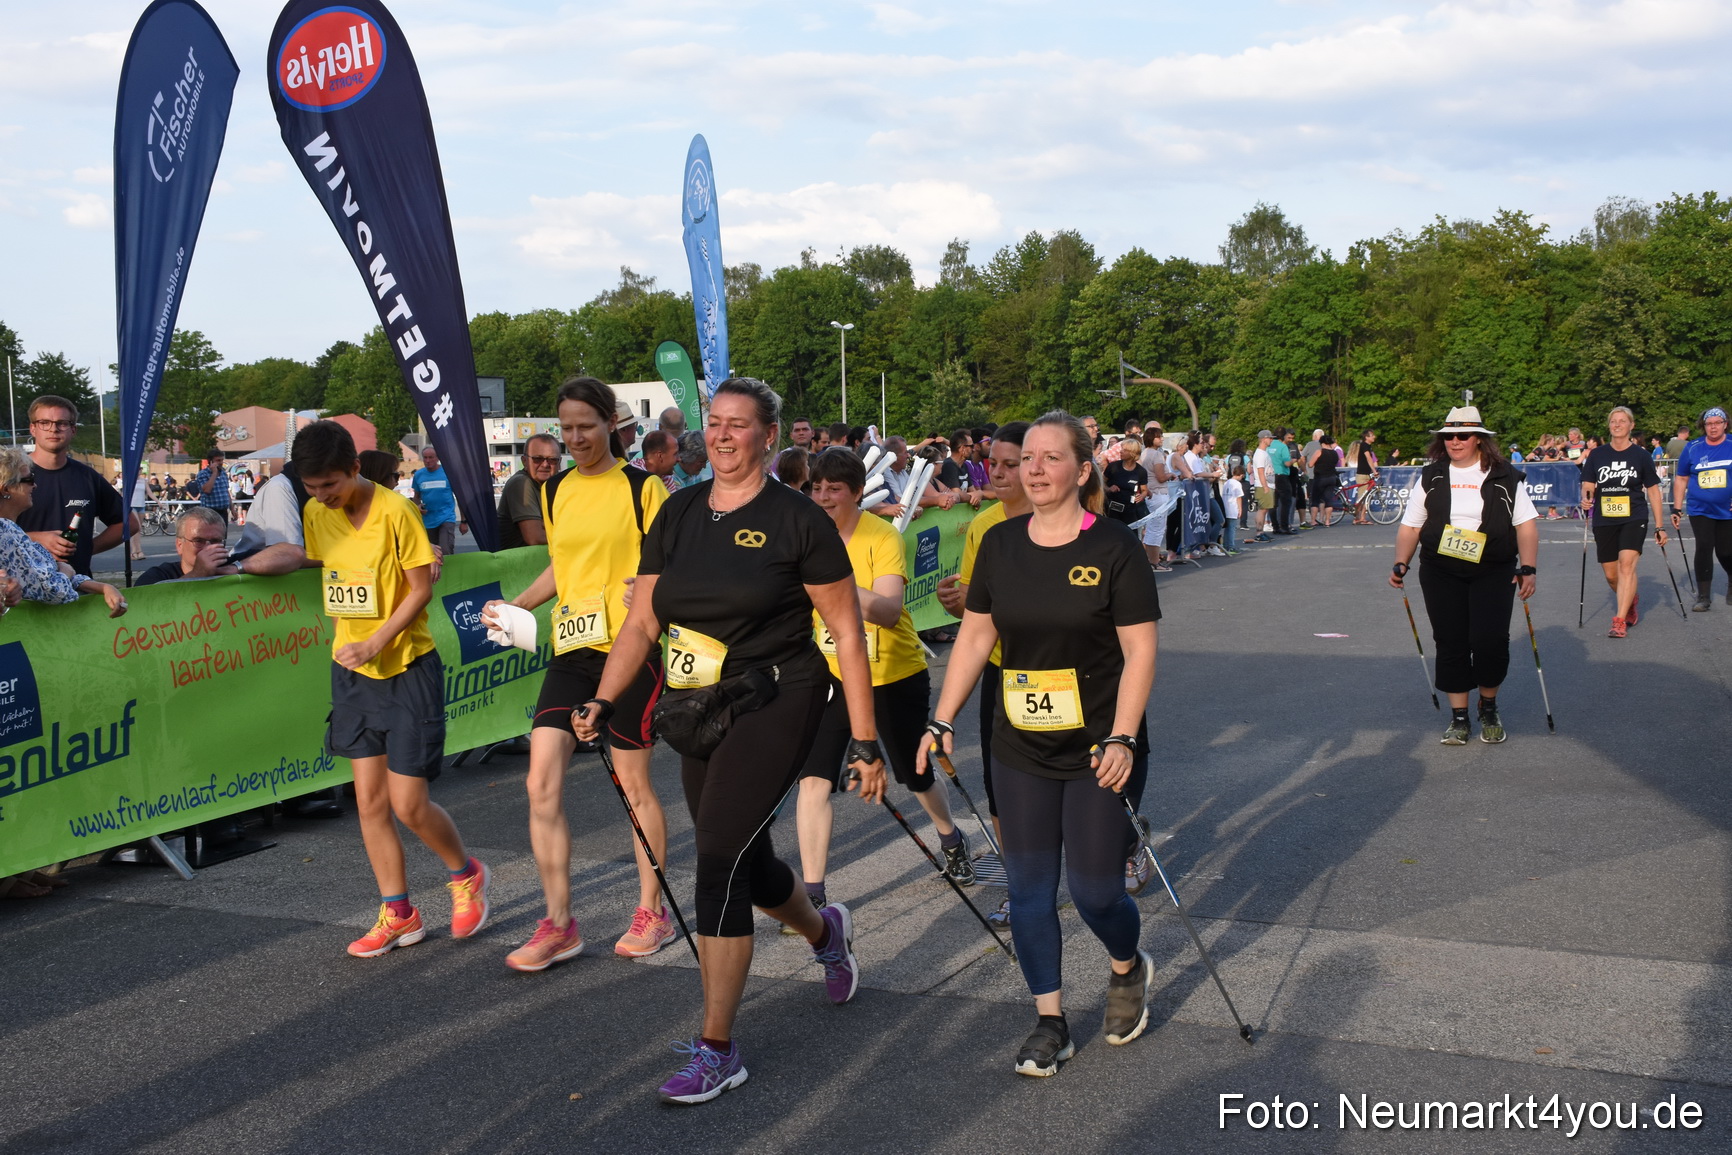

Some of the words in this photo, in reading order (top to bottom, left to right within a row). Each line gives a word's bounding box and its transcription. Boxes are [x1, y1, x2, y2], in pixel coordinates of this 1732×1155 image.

[160, 46, 198, 163] Fischer
[177, 69, 205, 162] AUTOMOBILE
[1597, 465, 1638, 486] Burgis
[1606, 503, 1623, 511] 386
[1447, 537, 1478, 553] 1152
[328, 585, 368, 604] 2019
[113, 602, 221, 659] Gesunde
[225, 593, 300, 627] Firmen
[558, 613, 597, 640] 2007
[170, 643, 244, 688] laufen
[248, 614, 331, 665] länger!
[671, 648, 695, 674] 78
[1026, 692, 1054, 714] 54
[69, 747, 336, 838] www.firmenlauf-oberpfalz.de
